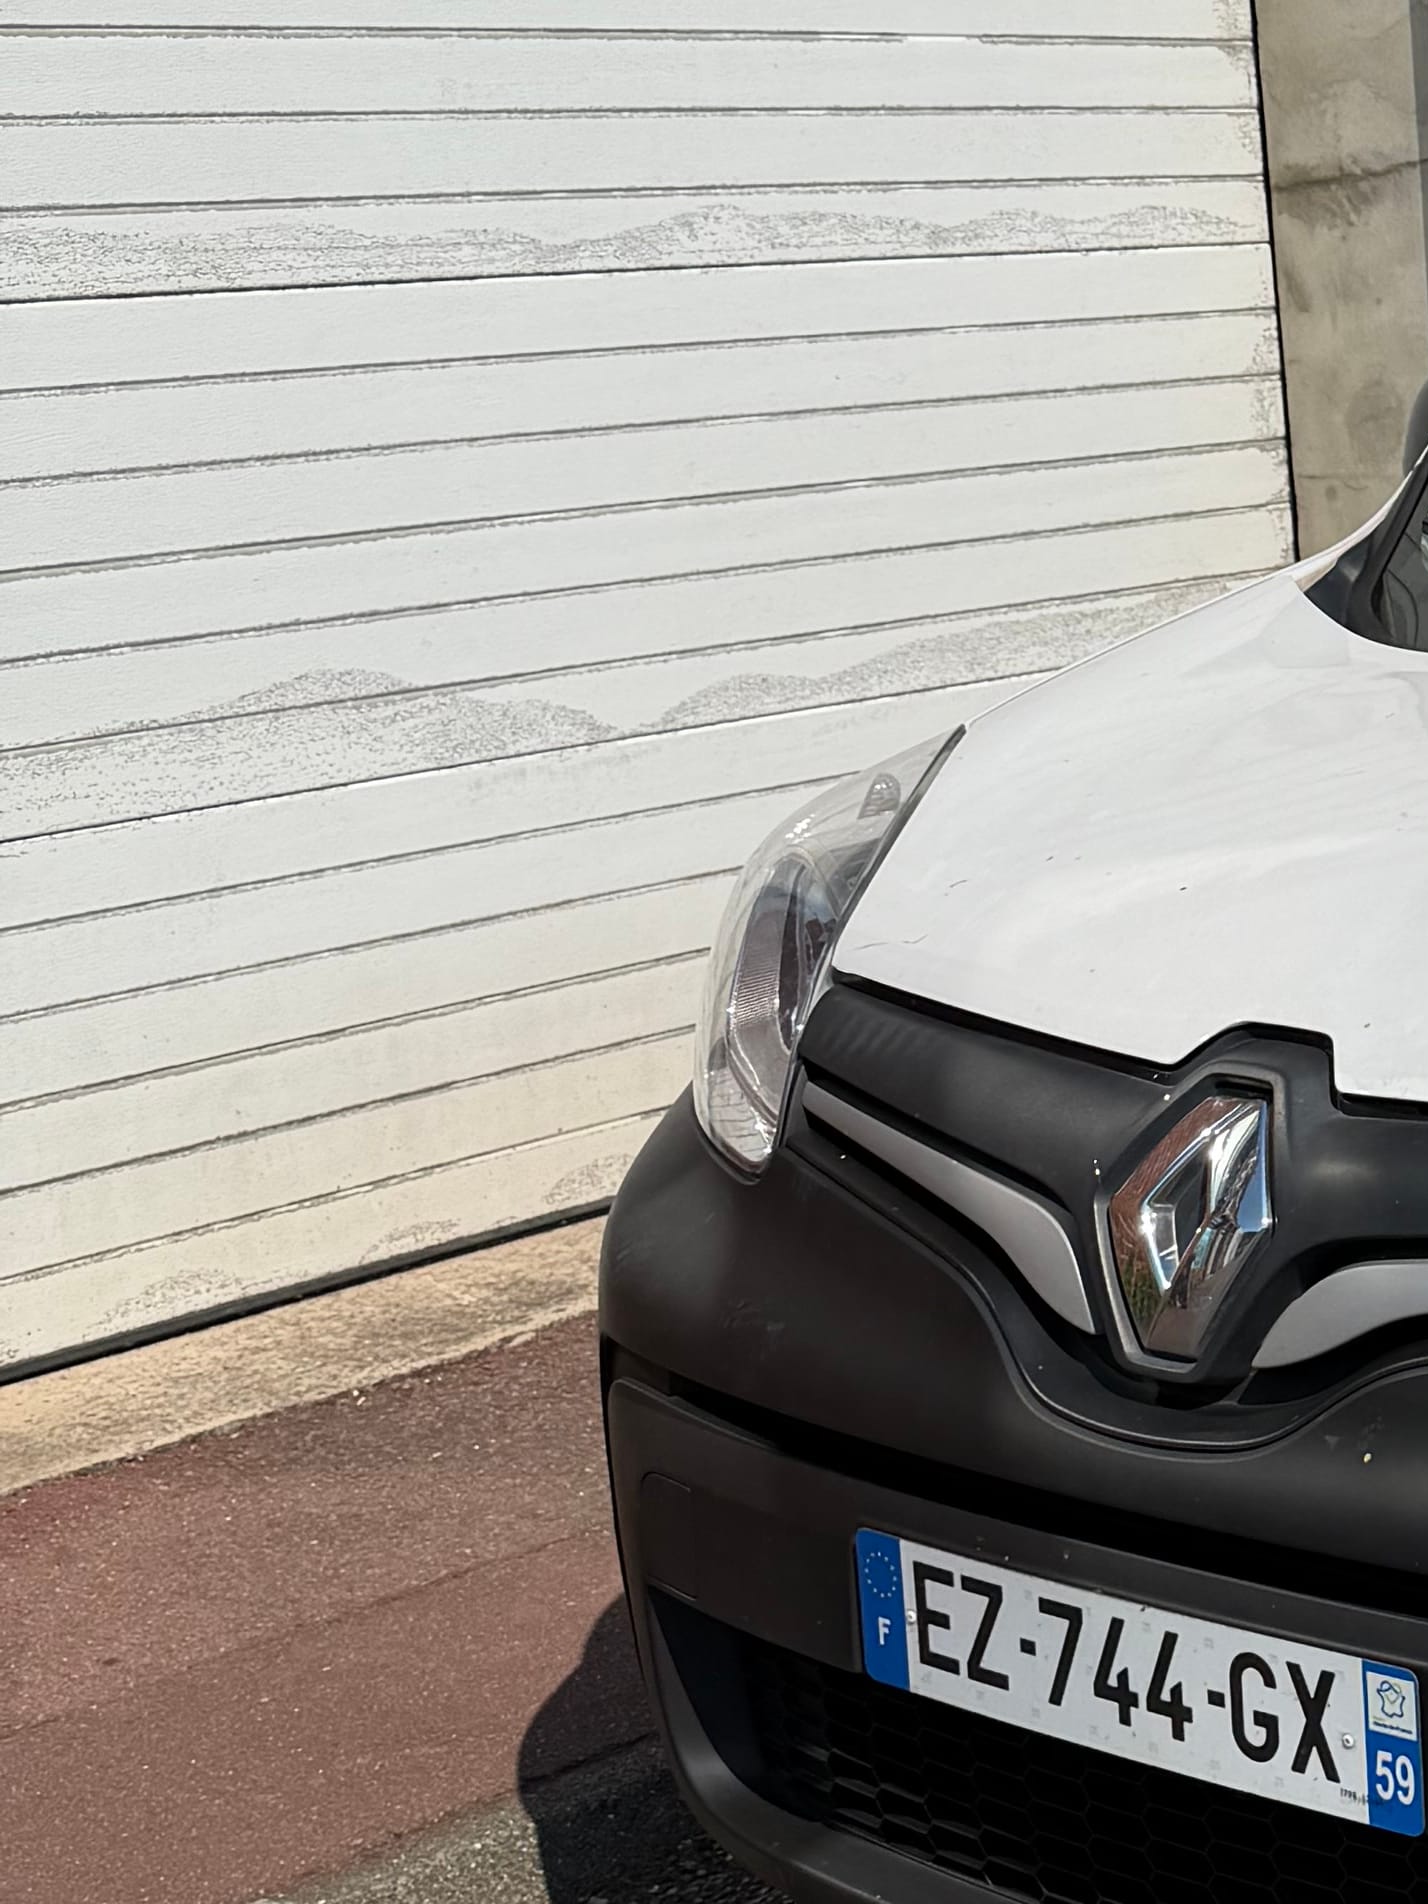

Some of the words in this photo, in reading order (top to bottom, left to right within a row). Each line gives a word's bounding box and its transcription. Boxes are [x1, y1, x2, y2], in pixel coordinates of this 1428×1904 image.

[877, 1615, 892, 1646] F
[912, 1560, 1341, 1784] EZ-744-GX
[1375, 1749, 1416, 1806] 59
